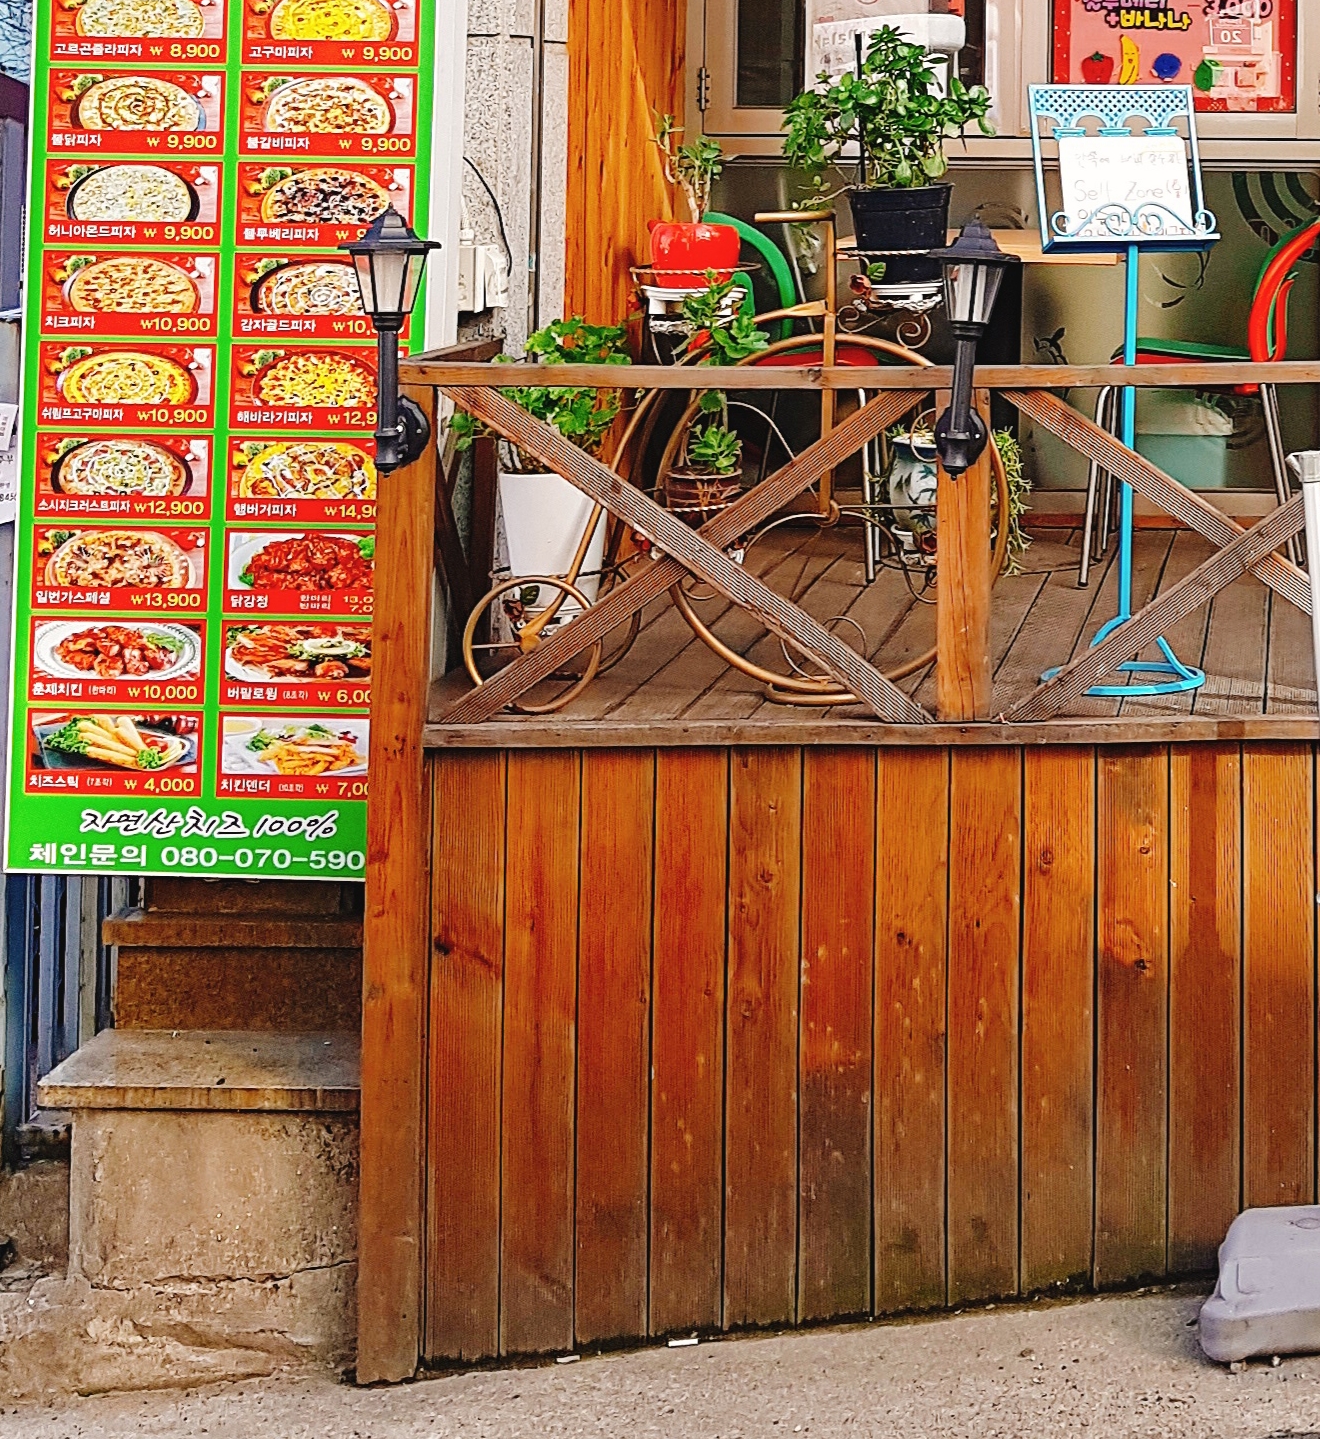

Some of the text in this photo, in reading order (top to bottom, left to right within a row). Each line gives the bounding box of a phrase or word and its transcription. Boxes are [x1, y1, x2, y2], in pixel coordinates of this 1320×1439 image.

[170, 44, 220, 59] 8,900
[248, 46, 313, 59] 고구마피자
[362, 46, 412, 62] 9,900
[167, 134, 217, 150] 9,900
[361, 137, 411, 153] 9,900
[48, 224, 137, 238] 허니아몬드피자
[164, 225, 214, 241] 9,900
[29, 774, 79, 788] 치즈스틱
[144, 778, 195, 793] 4,000
[253, 810, 340, 841] 100%
[28, 842, 366, 870] 체인문의 080-070-590
